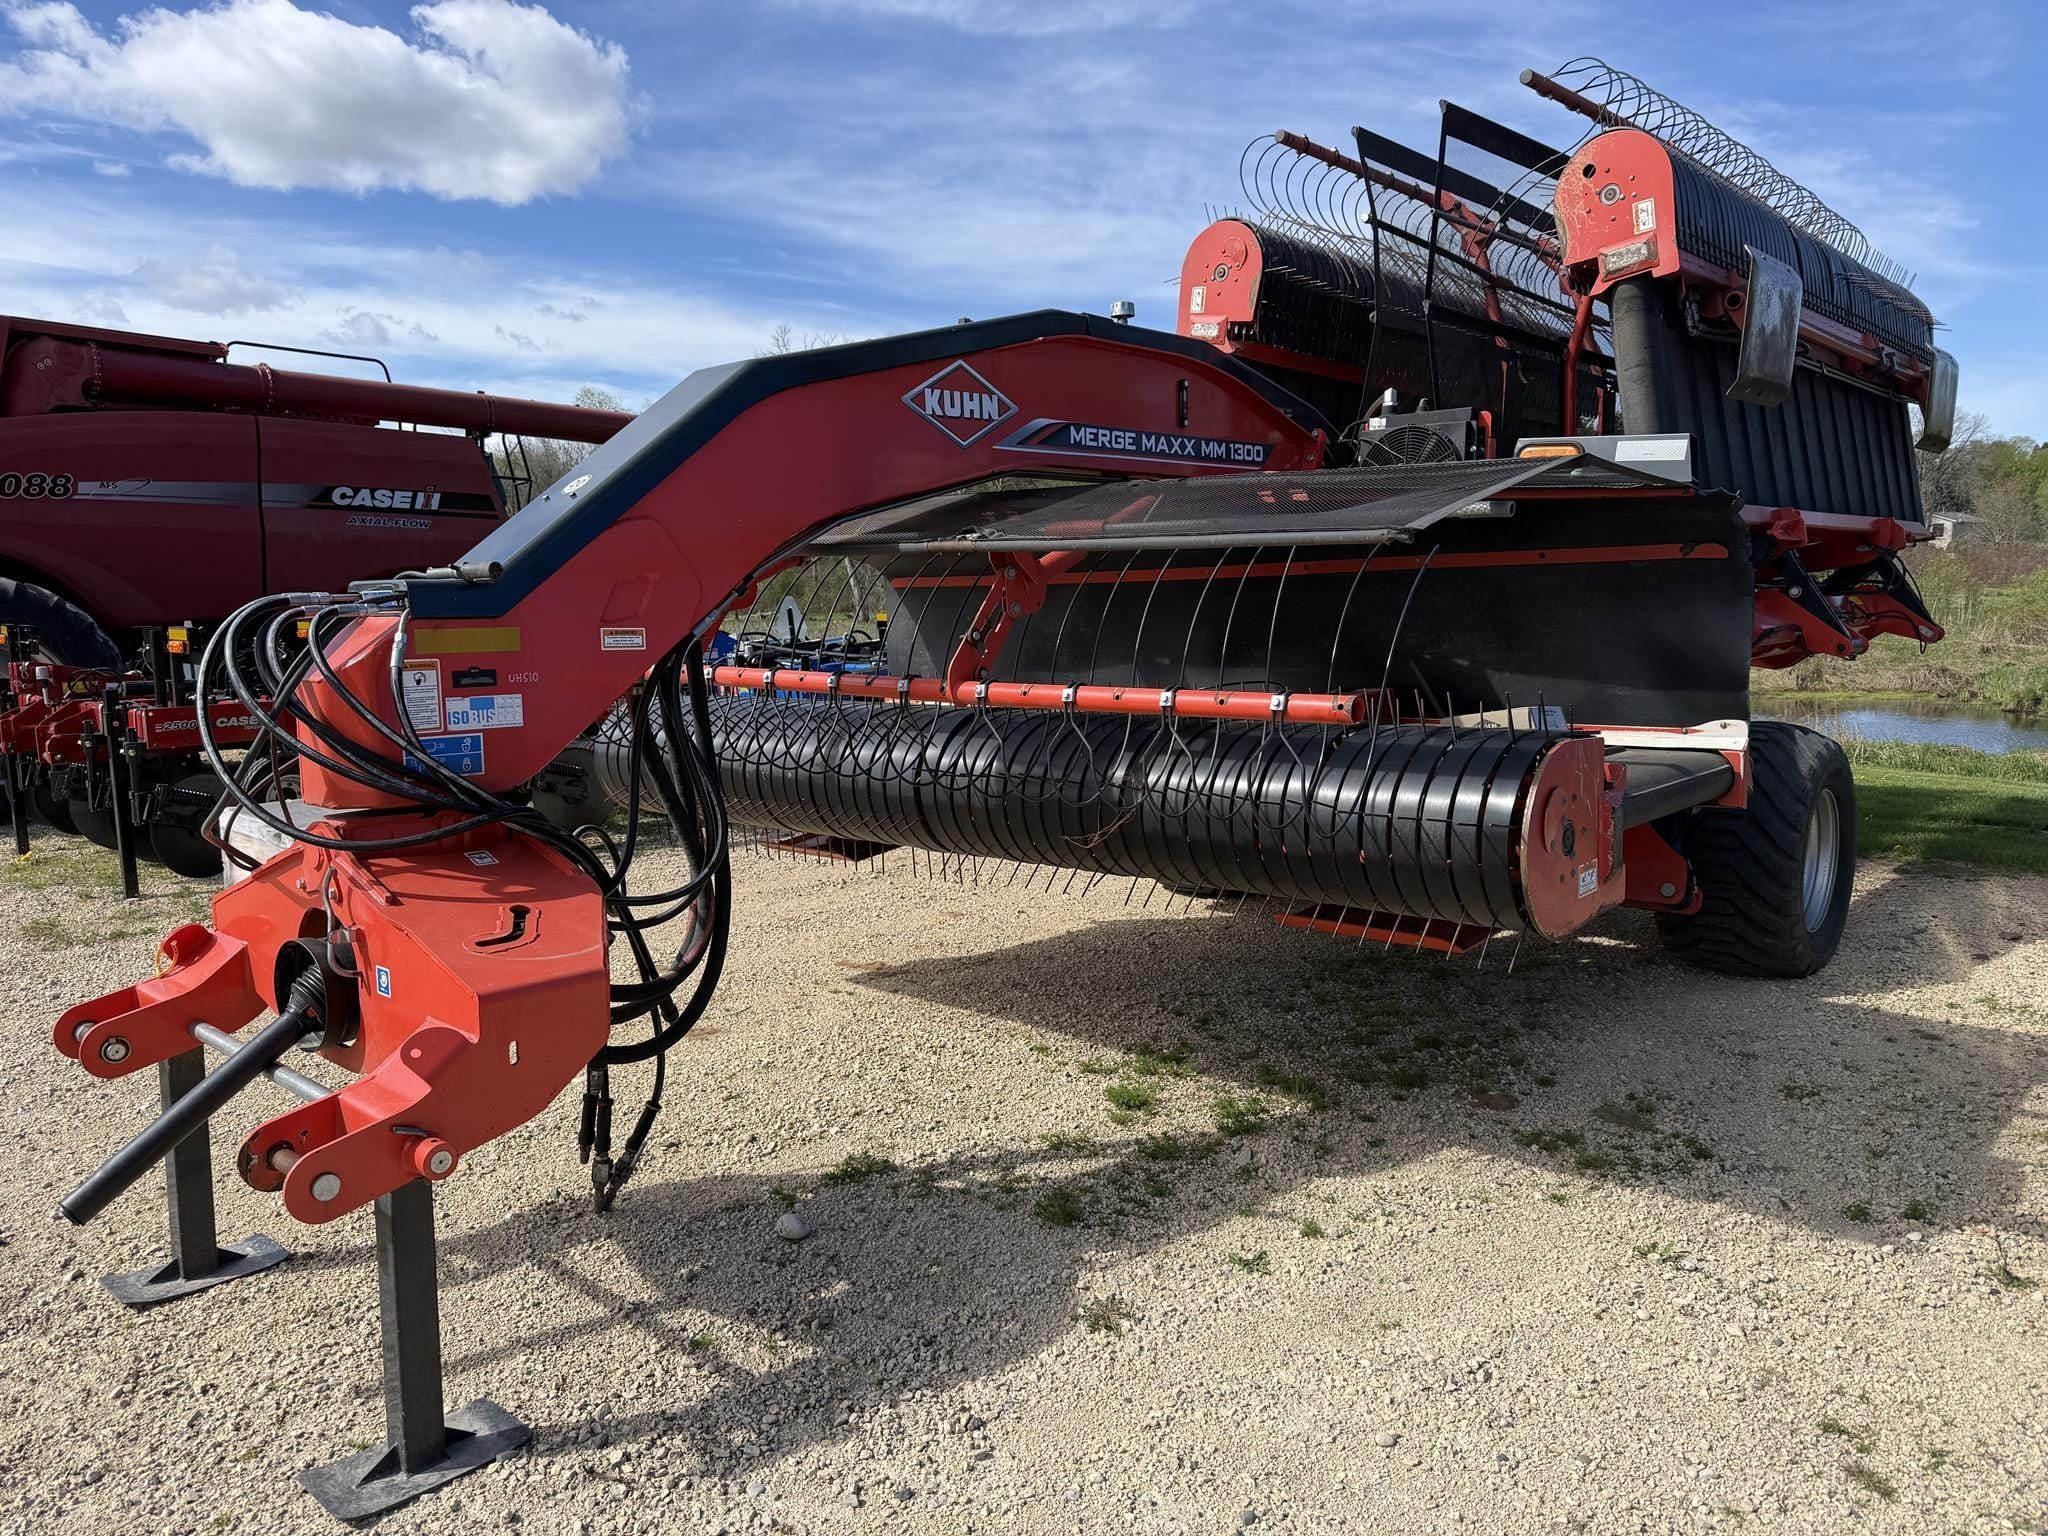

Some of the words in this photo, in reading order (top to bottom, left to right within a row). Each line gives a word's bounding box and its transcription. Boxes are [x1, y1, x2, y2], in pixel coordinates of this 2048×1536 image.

[924, 387, 999, 420] KUHN
[1070, 425, 1137, 451] MERGE
[1141, 433, 1196, 456] MAXX
[1201, 440, 1226, 459] MM
[1229, 443, 1264, 462] 1300
[0, 472, 73, 499] 088
[331, 486, 413, 509] CASE
[347, 515, 432, 529] AXIAL-FLOW
[162, 720, 198, 732] 2500
[216, 716, 259, 727] CASE
[447, 709, 496, 725] ISOBUS
